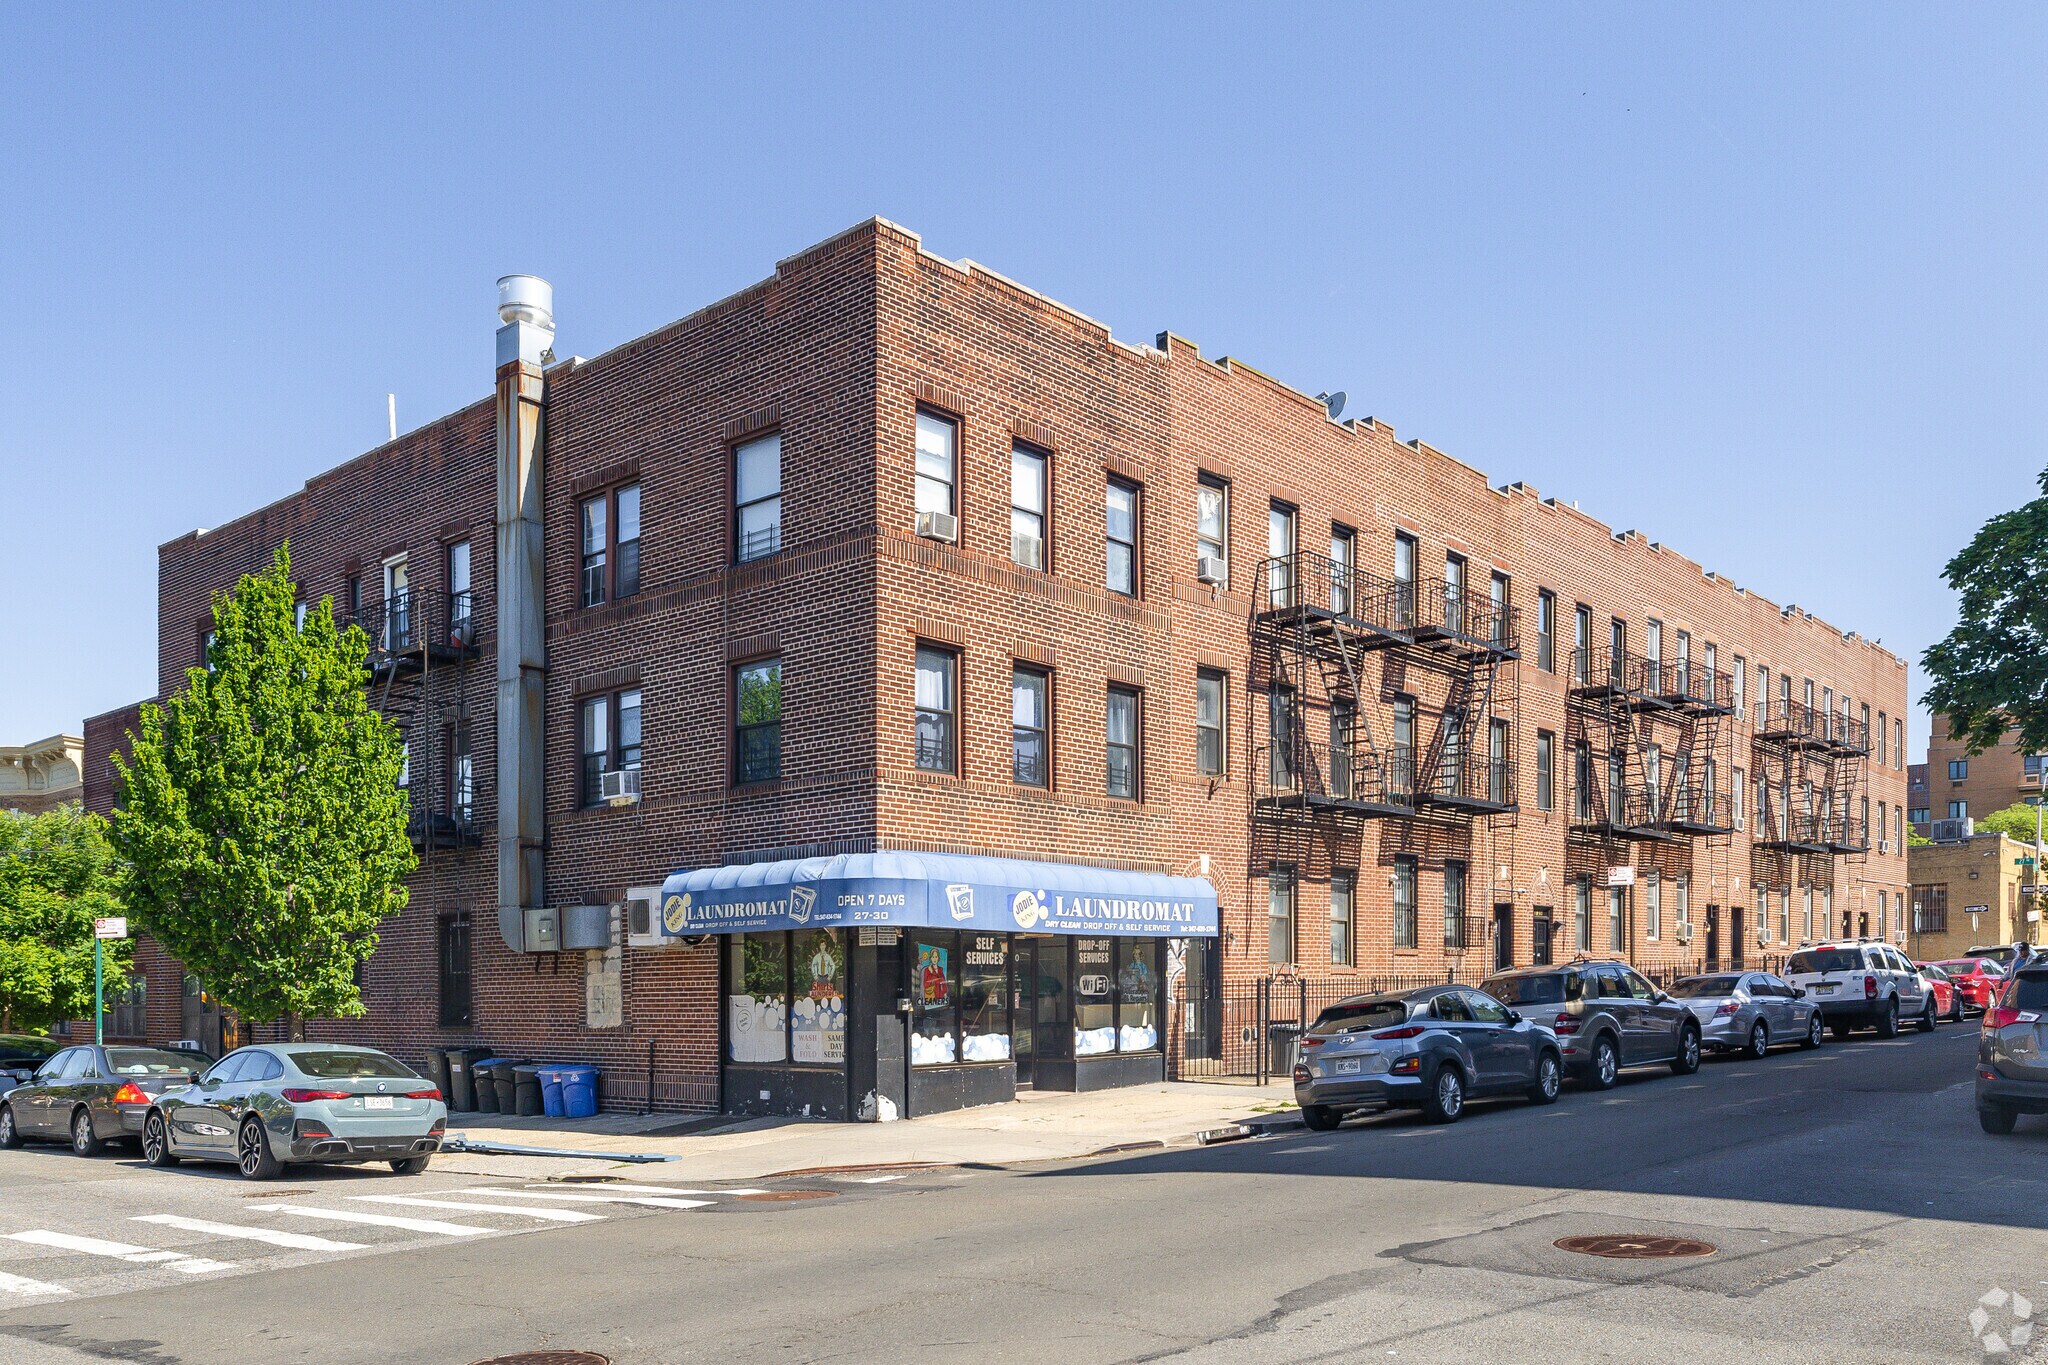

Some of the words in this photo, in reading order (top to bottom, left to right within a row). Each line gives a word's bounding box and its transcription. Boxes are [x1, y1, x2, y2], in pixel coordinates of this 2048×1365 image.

[837, 895, 864, 907] OPEN
[867, 894, 875, 906] 7
[878, 894, 905, 906] DAYS
[1015, 895, 1034, 915] JODIE
[665, 897, 681, 921] JODIE
[687, 900, 788, 921] LAUNDROMAT
[1055, 896, 1194, 922] LAUNDROMAT
[854, 911, 889, 920] 27-30
[1044, 920, 1059, 928] DRY
[1060, 921, 1081, 929] CLEAN
[1083, 922, 1103, 930] DROP
[1104, 922, 1118, 930] OFF
[1119, 923, 1124, 931] &
[1125, 923, 1142, 931] SELF
[1143, 924, 1171, 932] SERVICE
[976, 937, 995, 950] SELF
[1078, 939, 1110, 951] DROP-OFF
[966, 951, 1004, 965] SERVICES
[1078, 952, 1109, 964] SERVICES
[917, 996, 949, 1006] CLEANERS
[798, 1034, 817, 1042] WASH
[827, 1034, 845, 1042] SAME
[805, 1042, 811, 1050] &
[830, 1042, 843, 1050] DAY
[800, 1050, 817, 1058] FOLD
[823, 1050, 845, 1058] SERVIC
